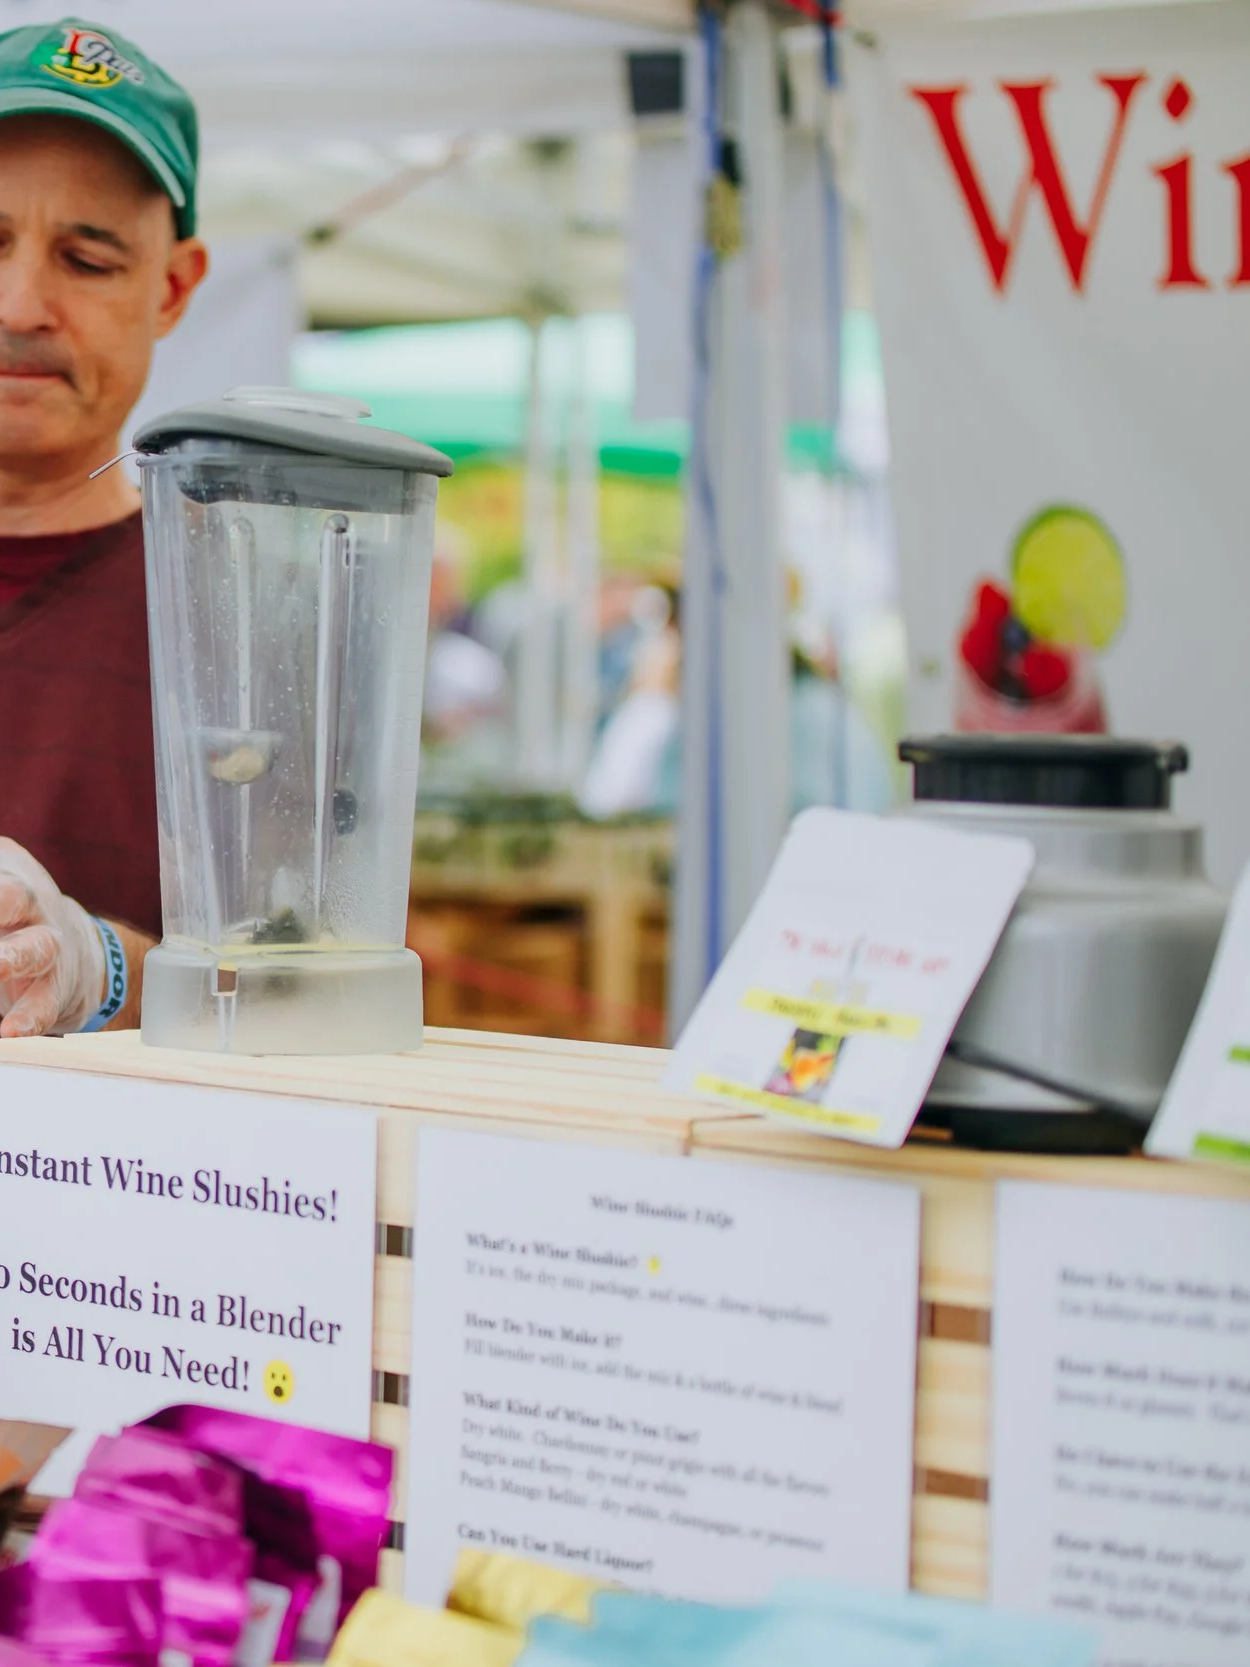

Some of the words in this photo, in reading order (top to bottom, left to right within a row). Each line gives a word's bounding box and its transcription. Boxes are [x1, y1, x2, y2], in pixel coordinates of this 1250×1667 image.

[100, 1156, 184, 1199] Wine
[192, 1169, 338, 1223] Slushies!
[19, 1262, 143, 1312] Seconds
[152, 1282, 180, 1319] in
[191, 1297, 207, 1324] a
[217, 1295, 342, 1346] Blender
[11, 1317, 35, 1352] is
[43, 1326, 85, 1362] All
[93, 1333, 151, 1374] You
[161, 1346, 250, 1393] Need!
[463, 1391, 501, 1412] What
[507, 1398, 542, 1418] Kind
[564, 1407, 602, 1428] Wine
[457, 1523, 486, 1543] Can
[490, 1529, 518, 1549] You
